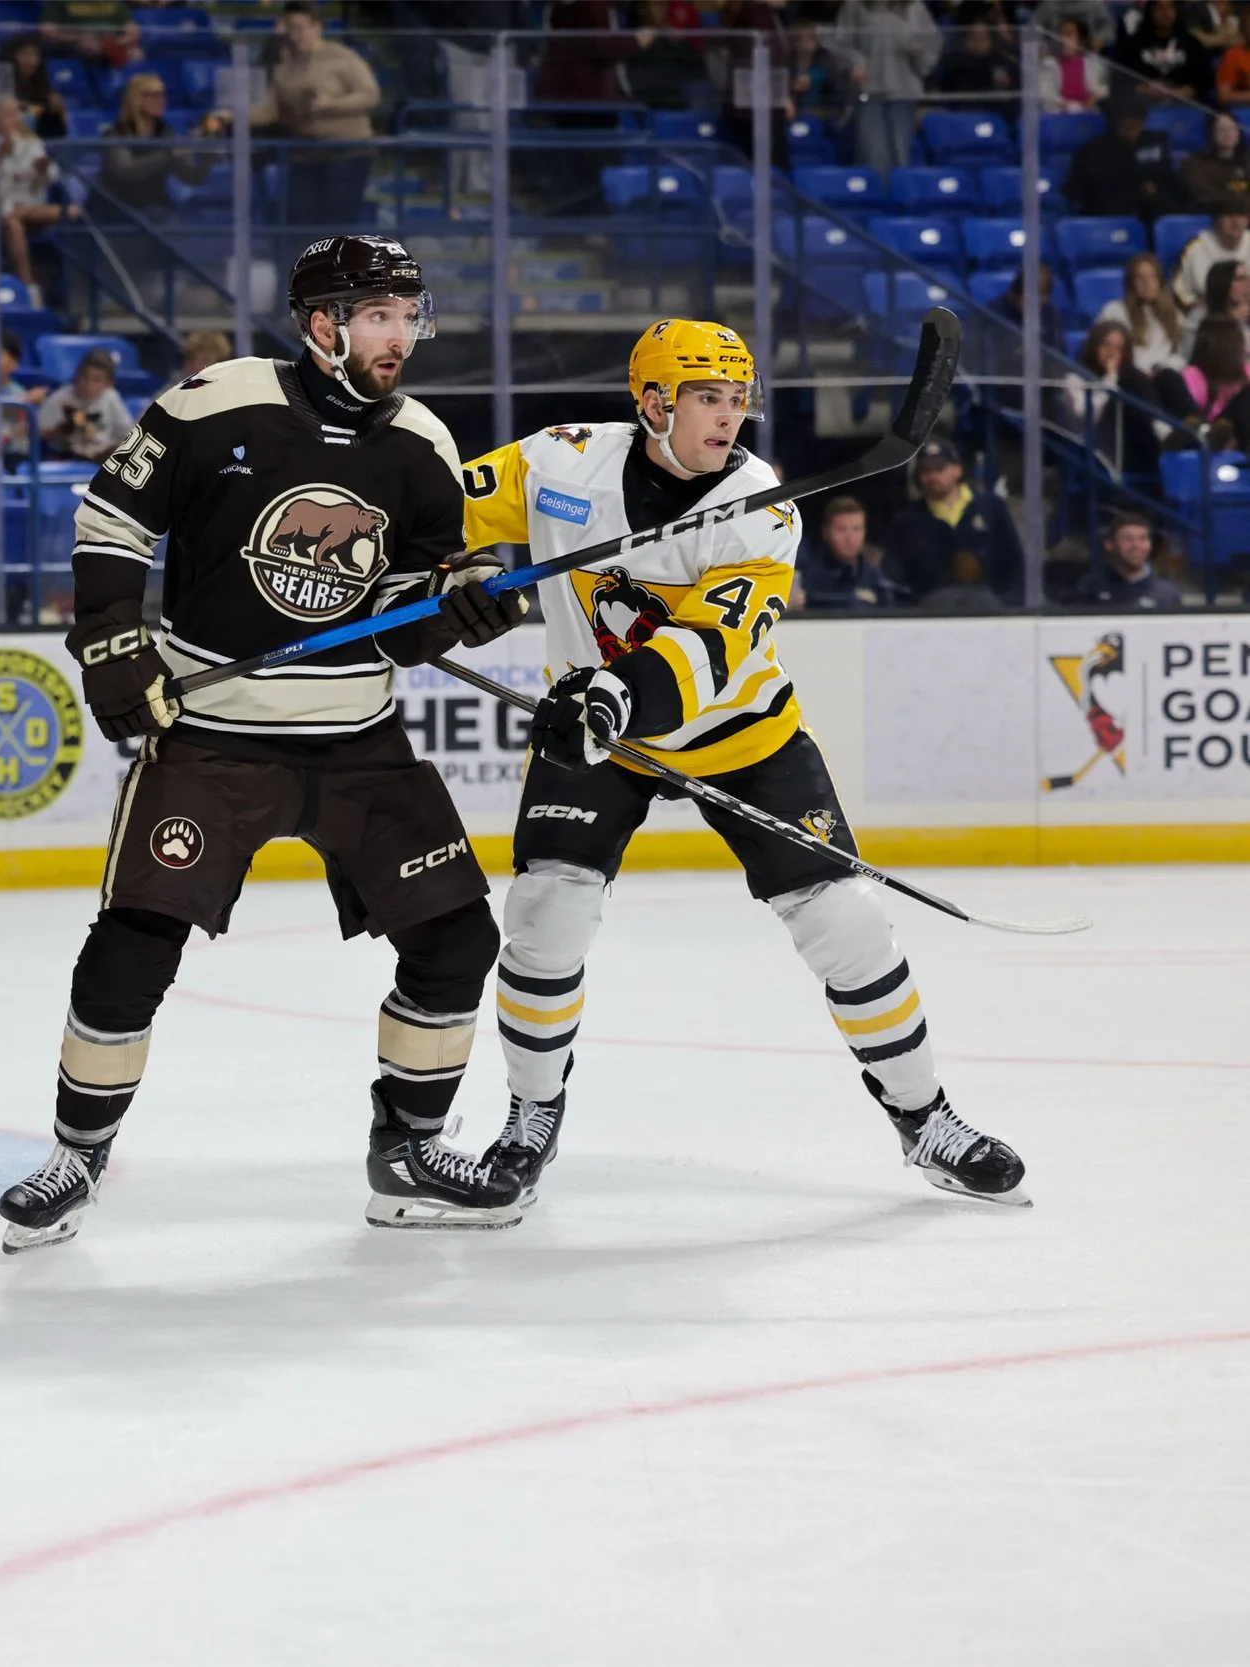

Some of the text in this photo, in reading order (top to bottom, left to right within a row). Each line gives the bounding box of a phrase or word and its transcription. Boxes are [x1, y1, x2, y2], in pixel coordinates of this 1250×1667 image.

[391, 268, 419, 276] CCM
[719, 355, 748, 363] CCM
[102, 423, 167, 490] 25
[539, 493, 589, 517] Geisinger
[619, 498, 747, 555] CCM
[282, 564, 341, 585] HERSHEY
[271, 571, 347, 609] BEARS
[702, 575, 788, 652] 42
[526, 805, 598, 824] CCM
[400, 838, 468, 879] CCM
[852, 862, 885, 883] CCM
